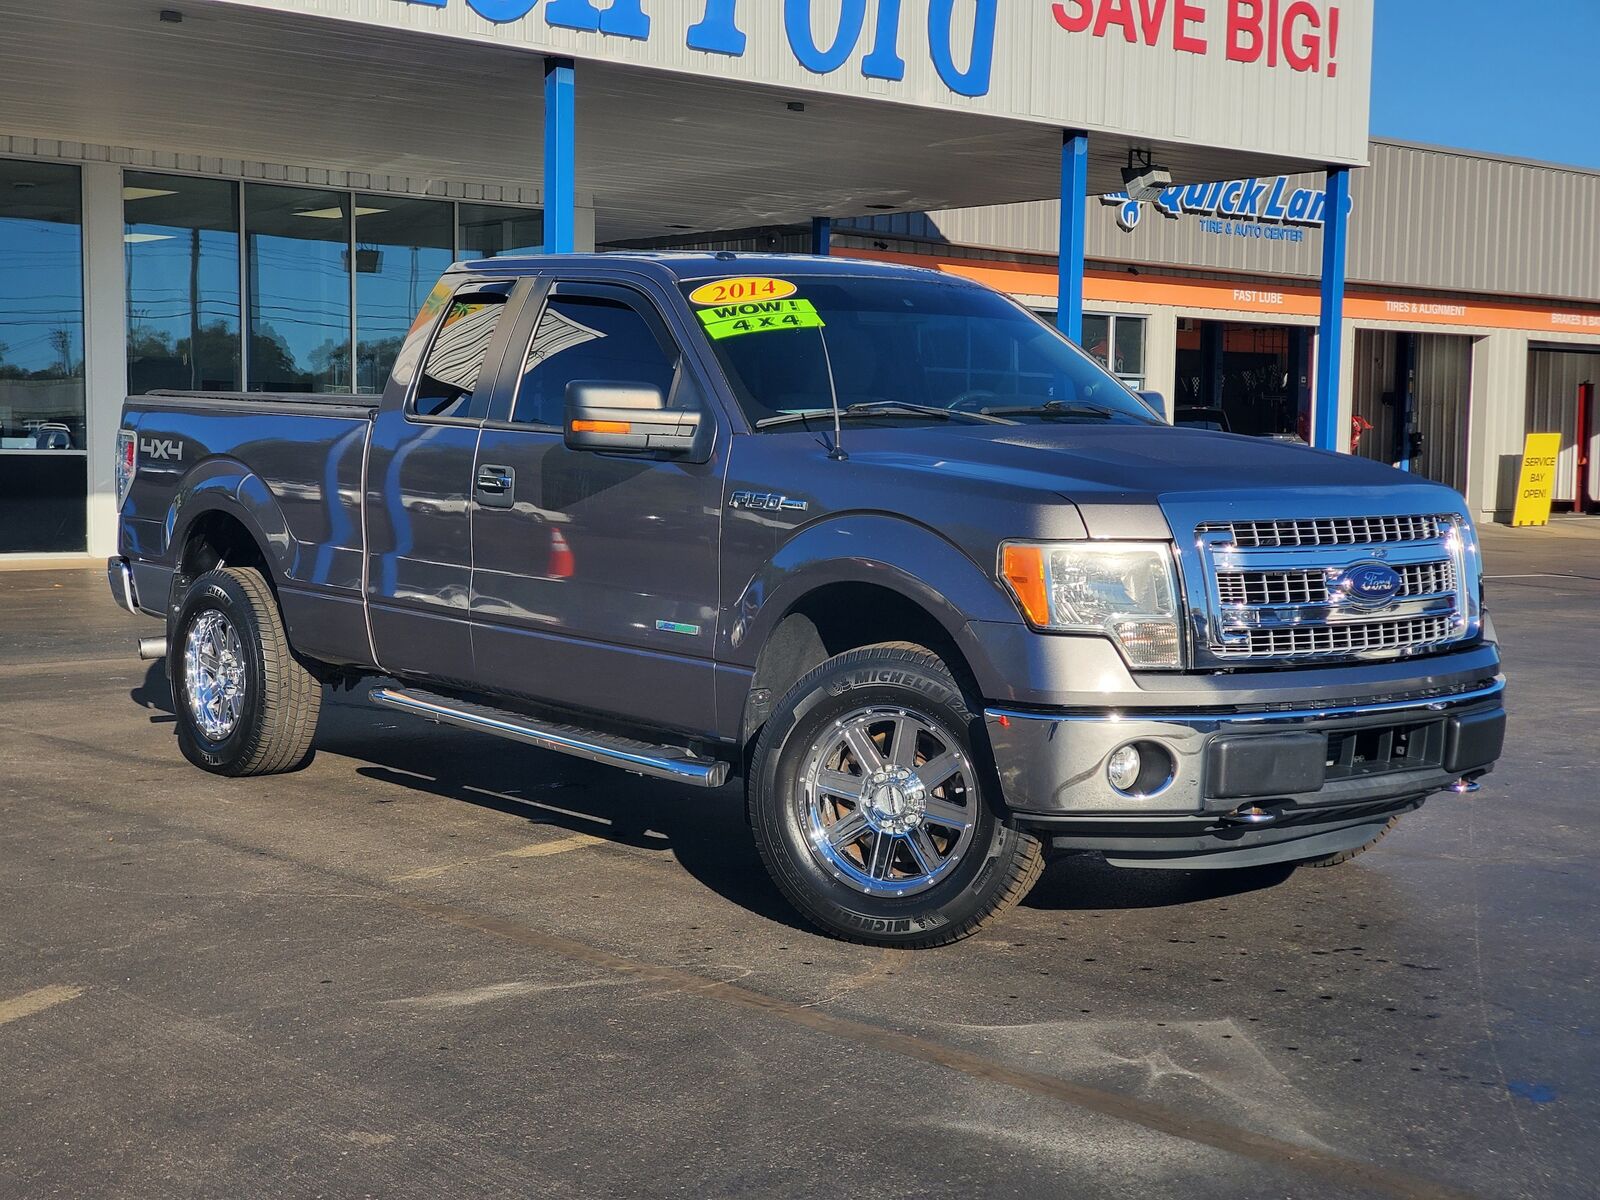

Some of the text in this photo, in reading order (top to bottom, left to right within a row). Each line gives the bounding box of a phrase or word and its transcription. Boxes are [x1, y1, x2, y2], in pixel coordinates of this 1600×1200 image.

[1226, 0, 1339, 77] BIG!
[1262, 175, 1354, 223] Lan
[1199, 219, 1304, 242] TIRE & AUTO CENTER
[712, 280, 776, 301] 2014
[1233, 289, 1283, 304] FAST LUBE
[1385, 301, 1466, 316] TIRES & ALIGNMENT
[1524, 457, 1556, 466] SERVICE
[1530, 473, 1545, 482] BAY
[1523, 489, 1546, 498] OPEN!
[1361, 571, 1393, 591] Ford
[854, 670, 946, 697] MICHELIN
